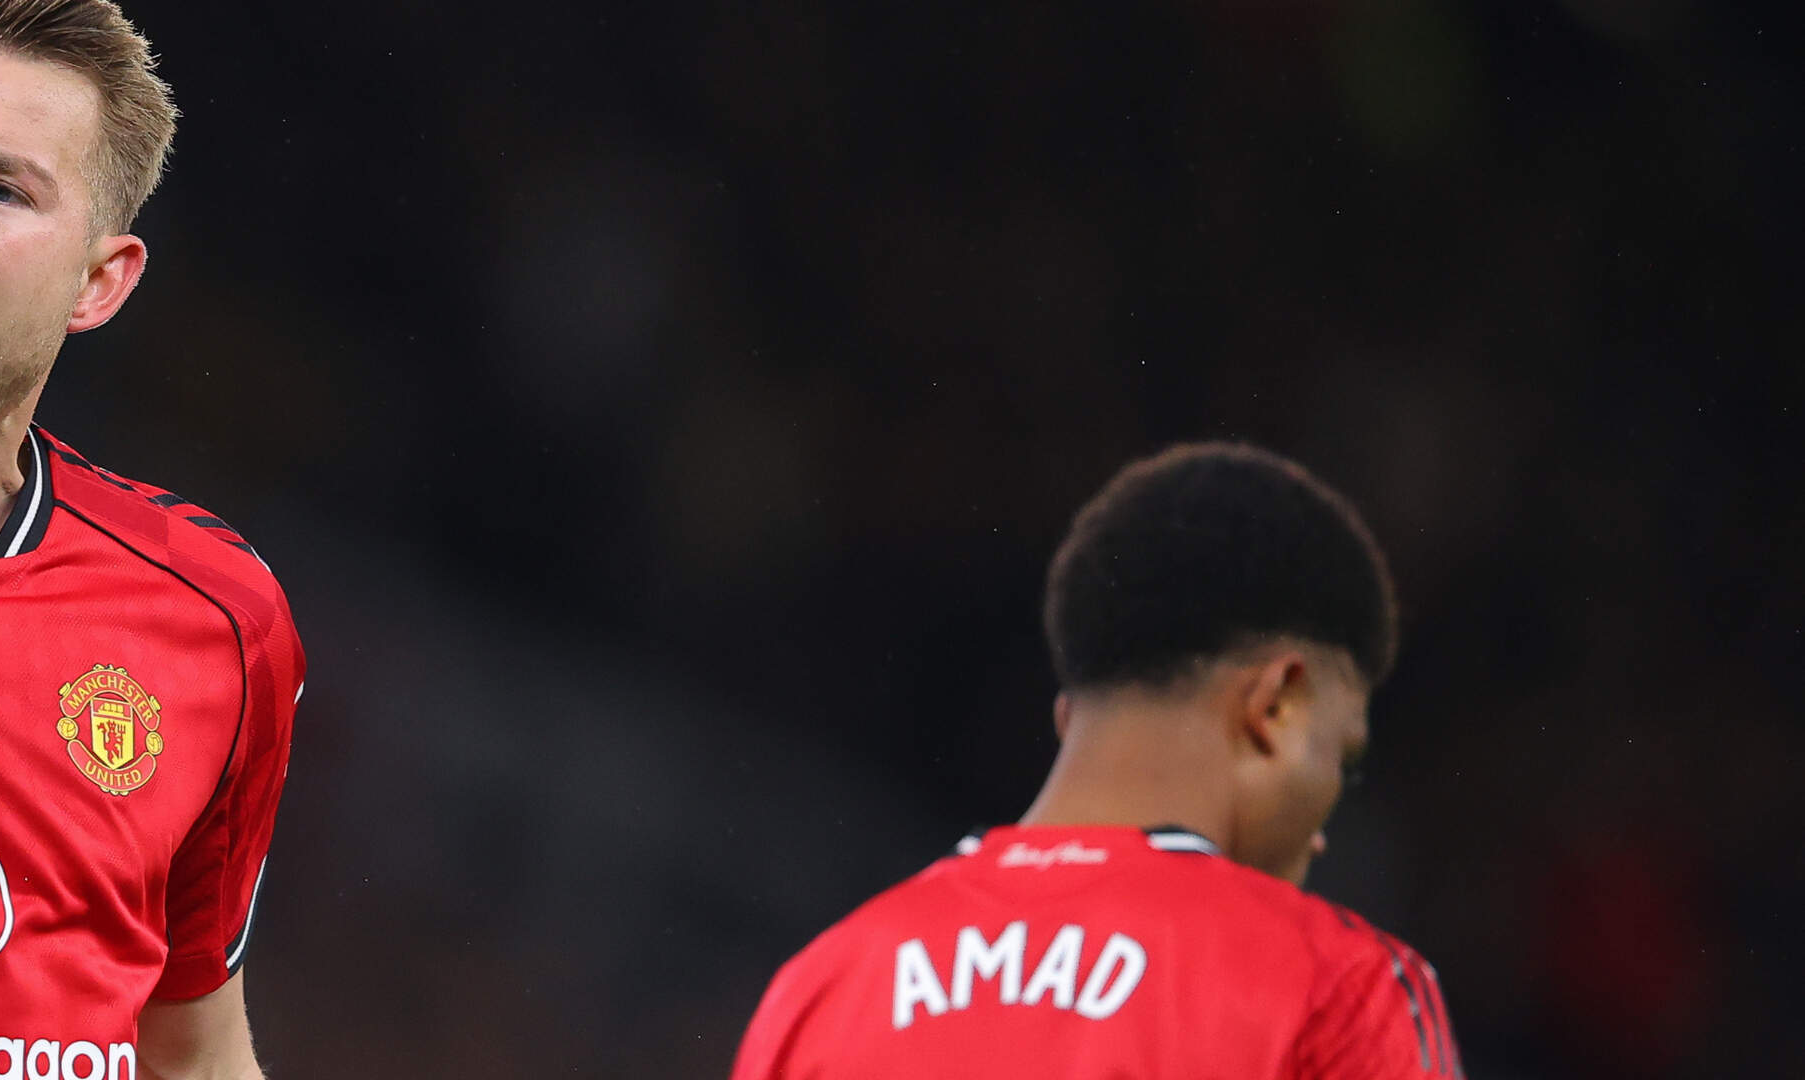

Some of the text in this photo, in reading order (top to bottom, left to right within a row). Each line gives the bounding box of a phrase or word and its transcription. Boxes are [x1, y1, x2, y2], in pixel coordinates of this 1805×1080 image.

[67, 674, 154, 722] MANCHESTER
[85, 761, 142, 786] UNITED
[891, 920, 1148, 1031] AMAD
